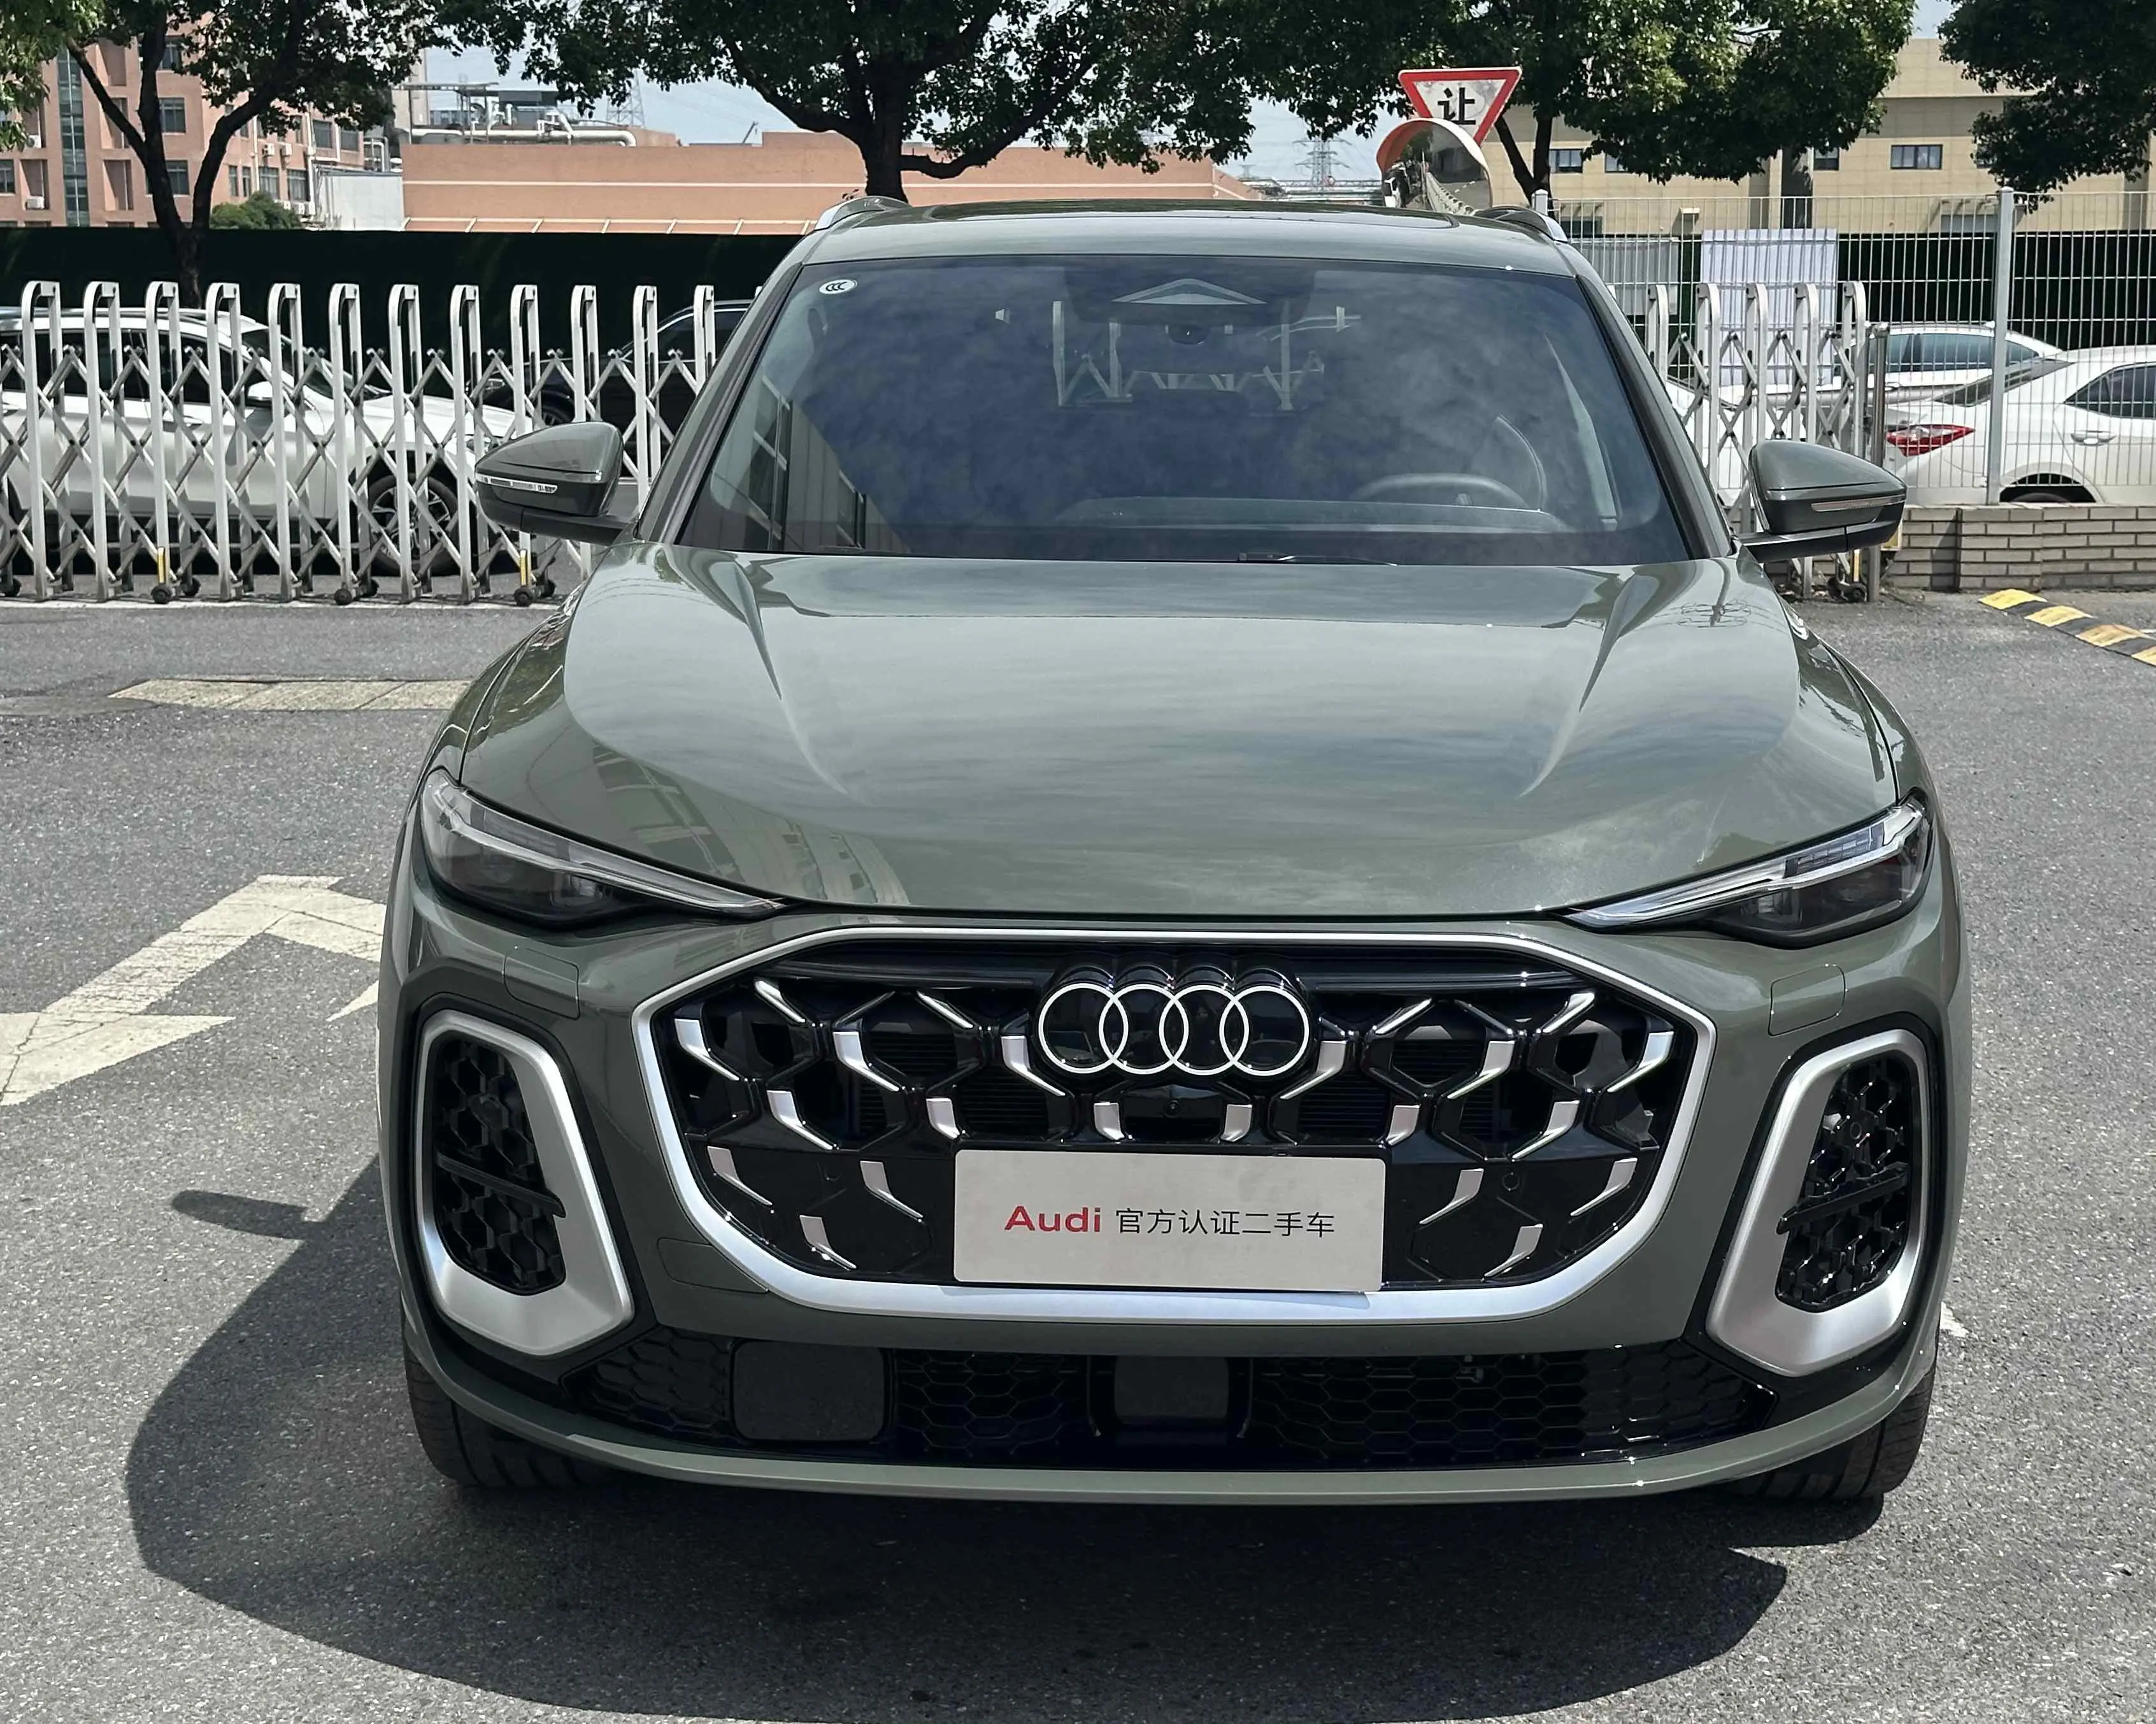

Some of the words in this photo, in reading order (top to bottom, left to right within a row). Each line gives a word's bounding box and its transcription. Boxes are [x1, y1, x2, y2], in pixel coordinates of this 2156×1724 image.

[1437, 87, 1476, 126] 让
[1004, 1205, 1101, 1233] Audi
[1115, 1207, 1336, 1238] 官方认证二手车
